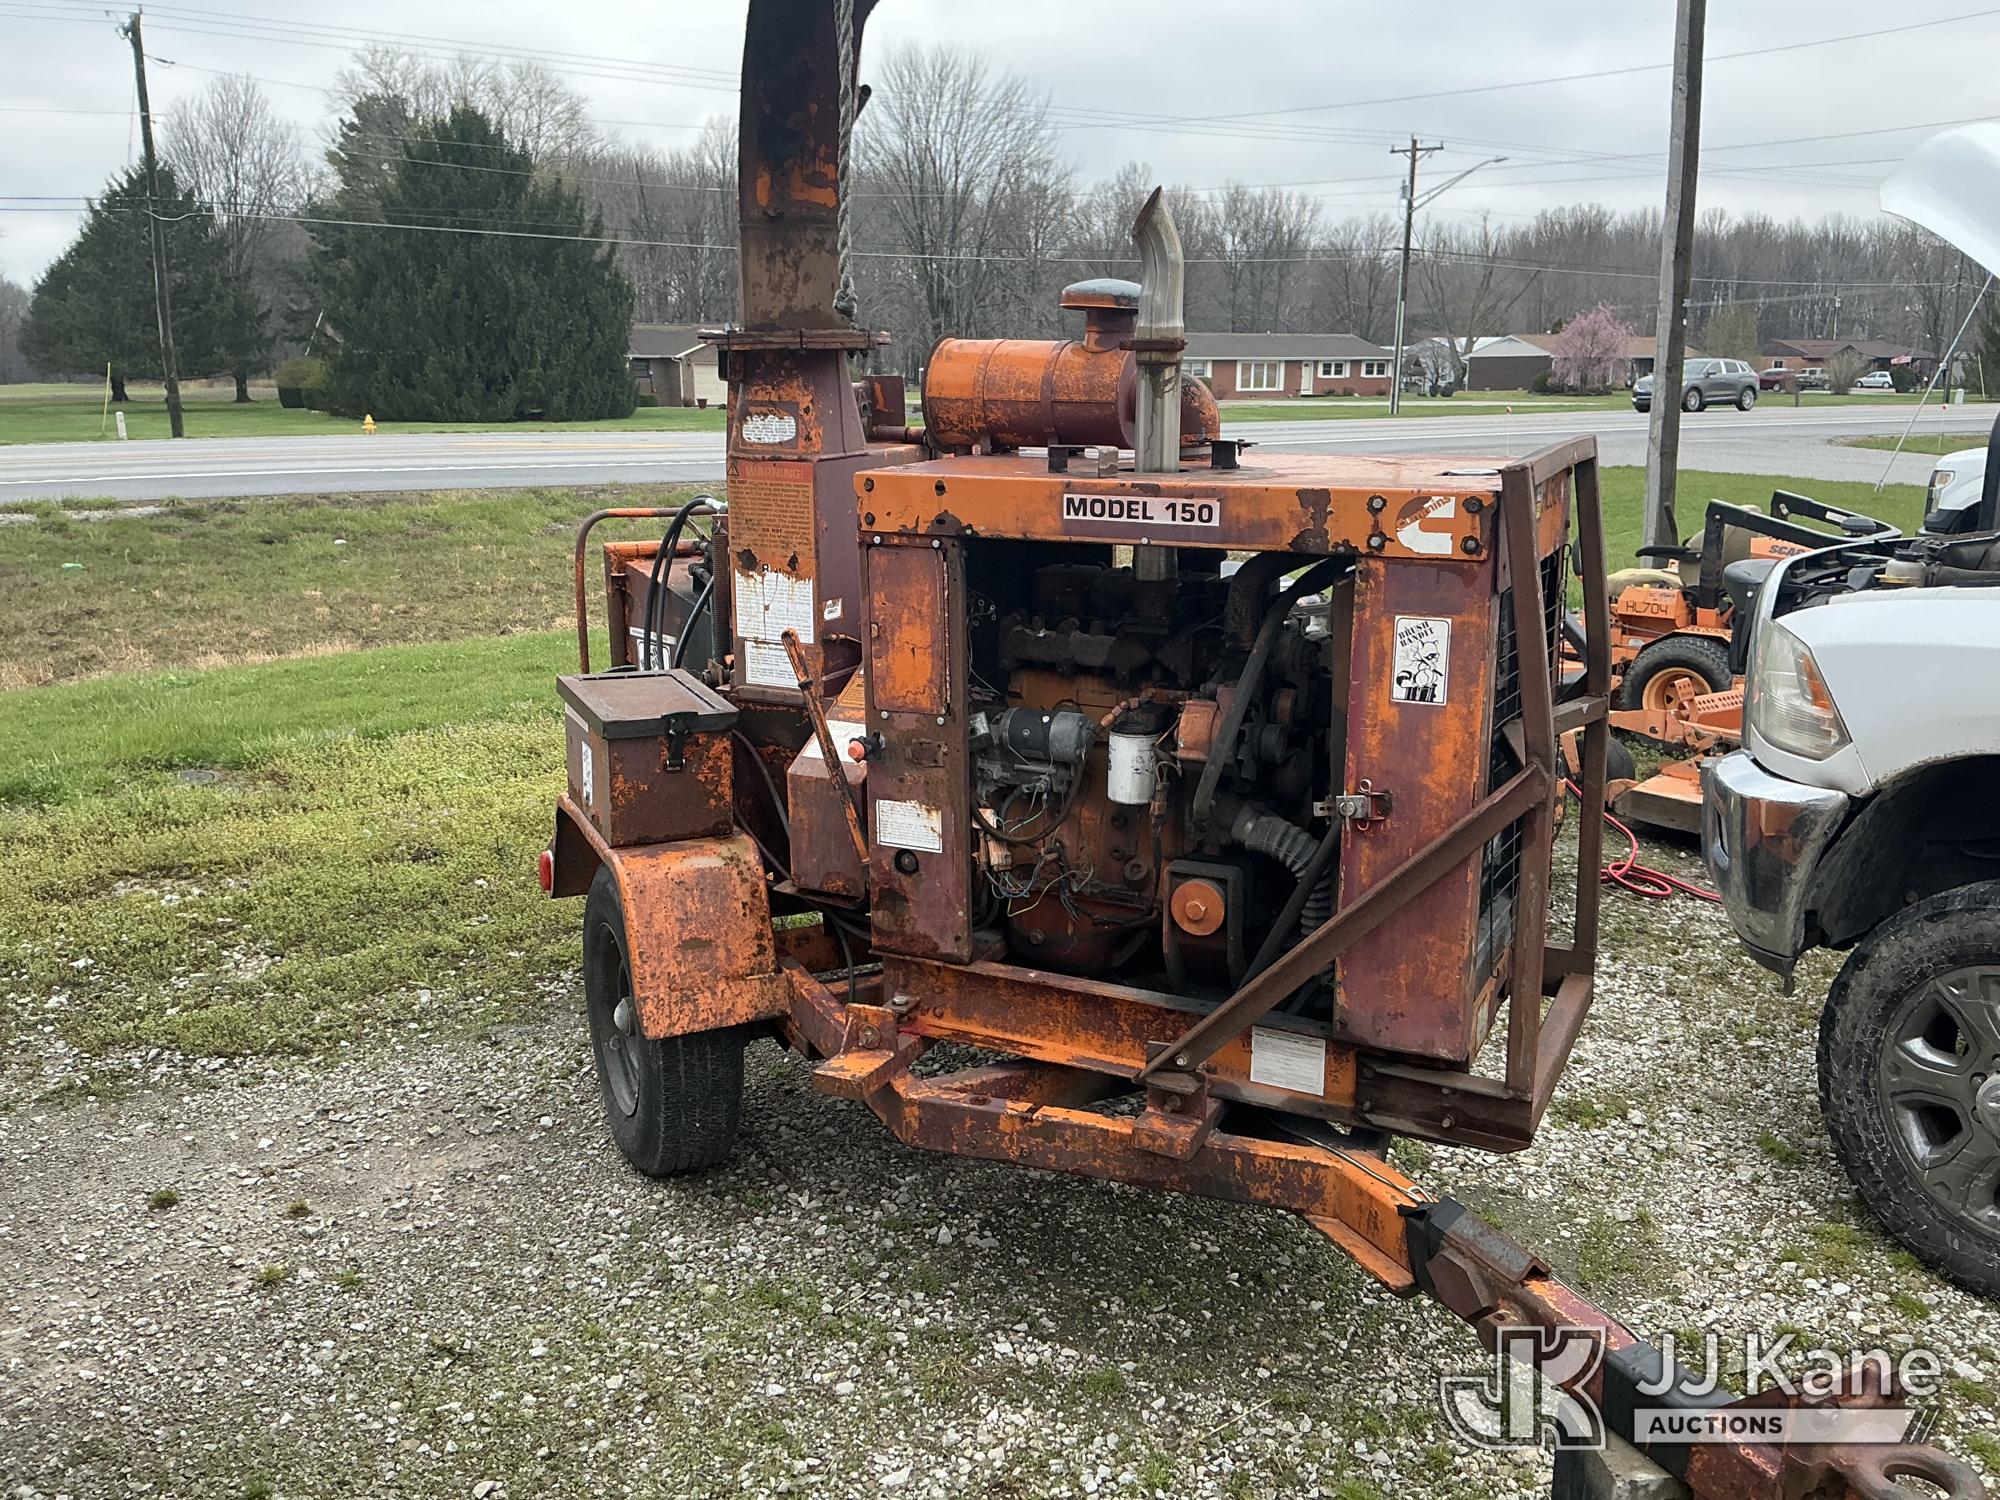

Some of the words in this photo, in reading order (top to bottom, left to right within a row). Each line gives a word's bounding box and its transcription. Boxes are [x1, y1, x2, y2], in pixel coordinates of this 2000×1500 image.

[744, 466, 805, 480] WARNING!
[1066, 497, 1154, 520] MODEL
[1164, 502, 1213, 523] 150
[1626, 600, 1668, 616] HL704
[1398, 621, 1429, 640] BRUSH
[1400, 627, 1434, 647] BANDIT
